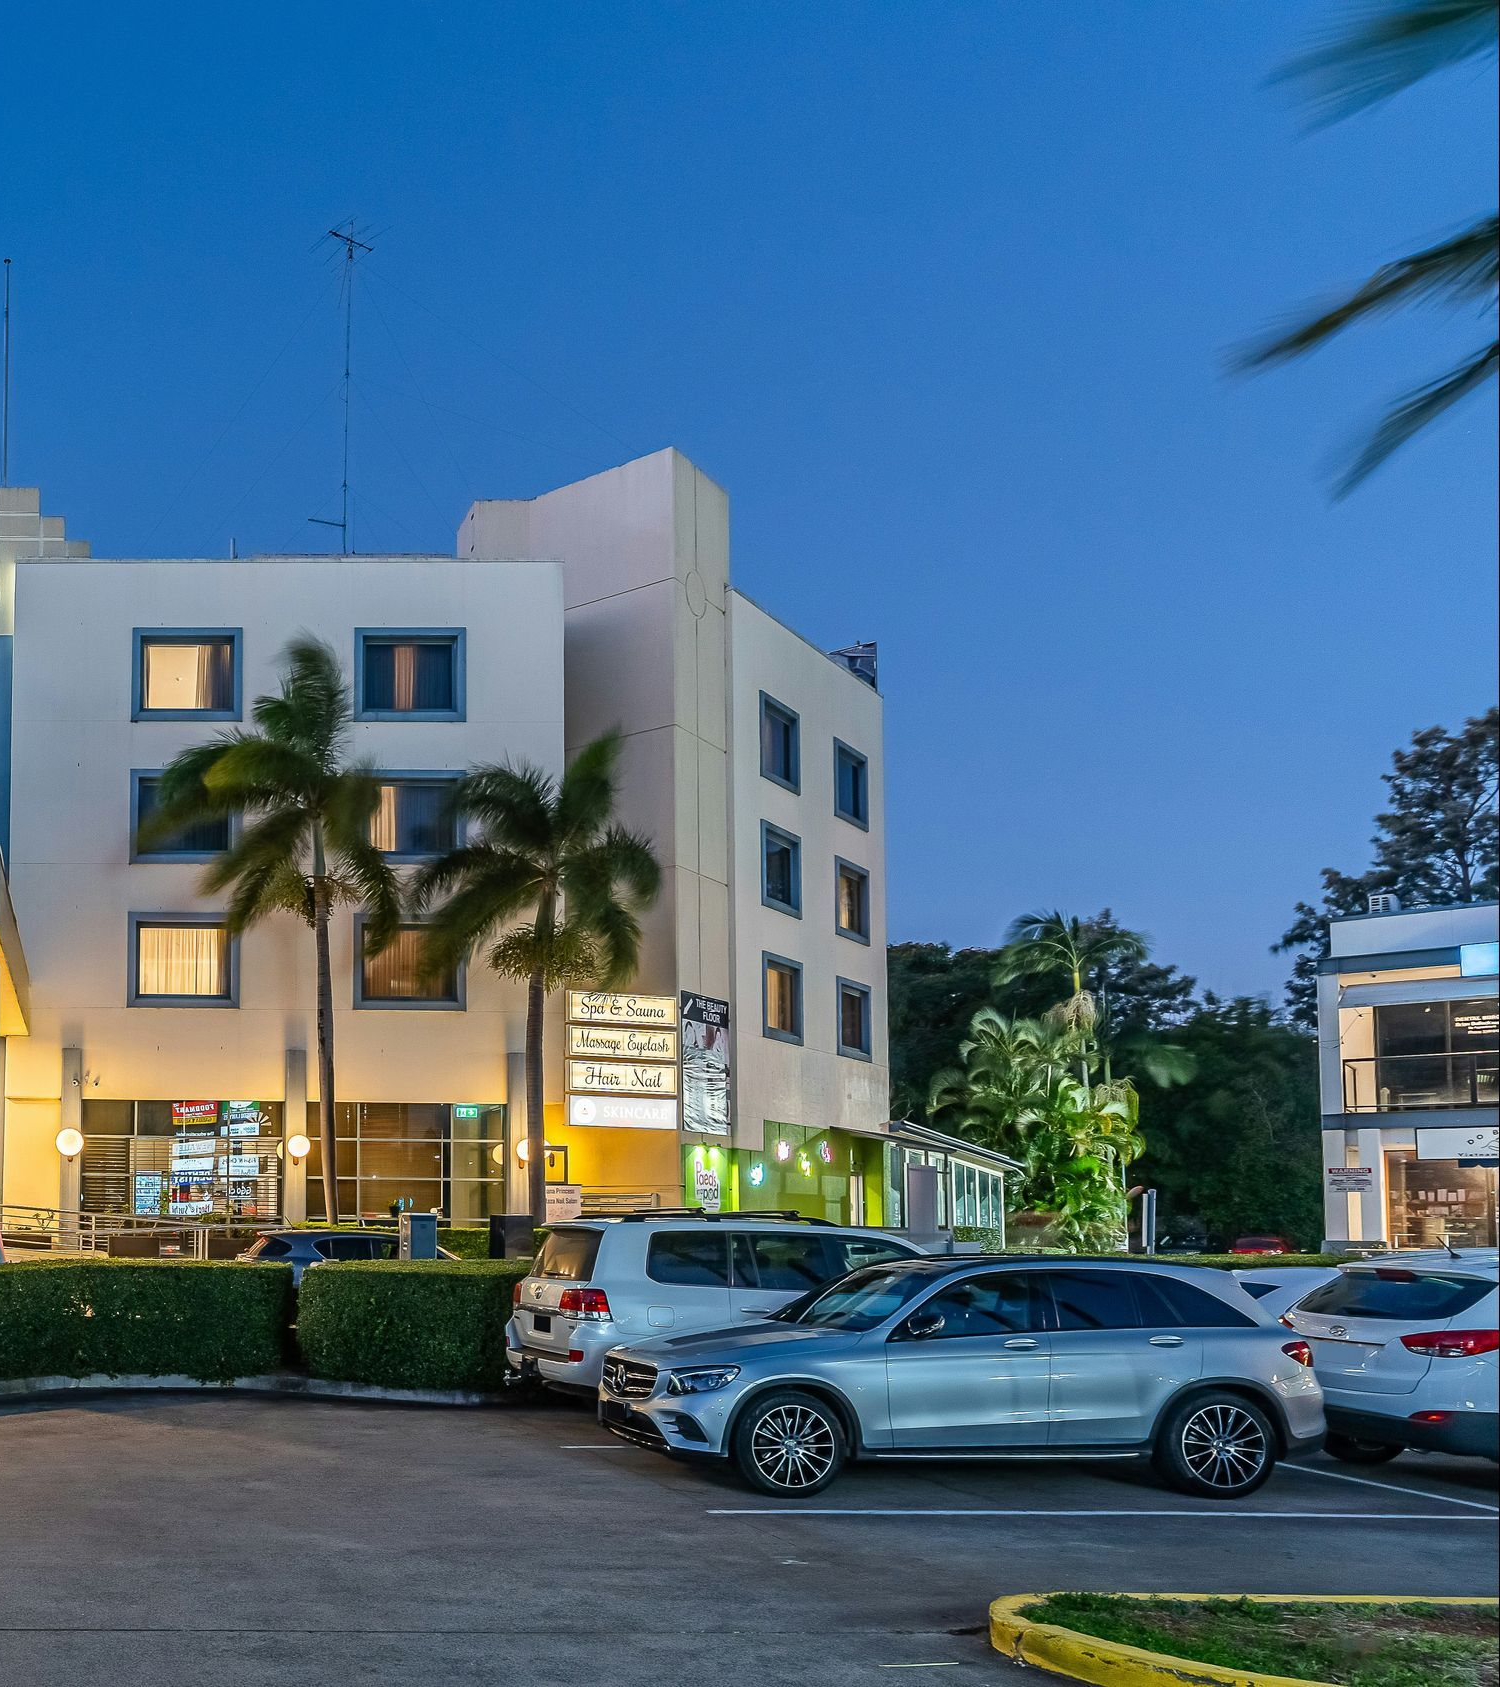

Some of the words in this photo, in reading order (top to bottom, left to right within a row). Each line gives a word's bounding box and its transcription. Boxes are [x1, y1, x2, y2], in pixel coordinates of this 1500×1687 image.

[580, 996, 605, 1019] Spa
[610, 998, 622, 1016] &
[626, 999, 666, 1018] Sauna
[696, 998, 706, 1009] THE
[707, 1001, 727, 1014] BEAUTY
[703, 1011, 720, 1023] FLOOR
[576, 1030, 622, 1053] Massage
[627, 1033, 669, 1055] Eyelash
[584, 1066, 620, 1086] Hair
[631, 1068, 662, 1088] Nail
[603, 1106, 669, 1120] SKINCARE
[695, 1161, 717, 1187] Paeds
[702, 1183, 719, 1204] pod
